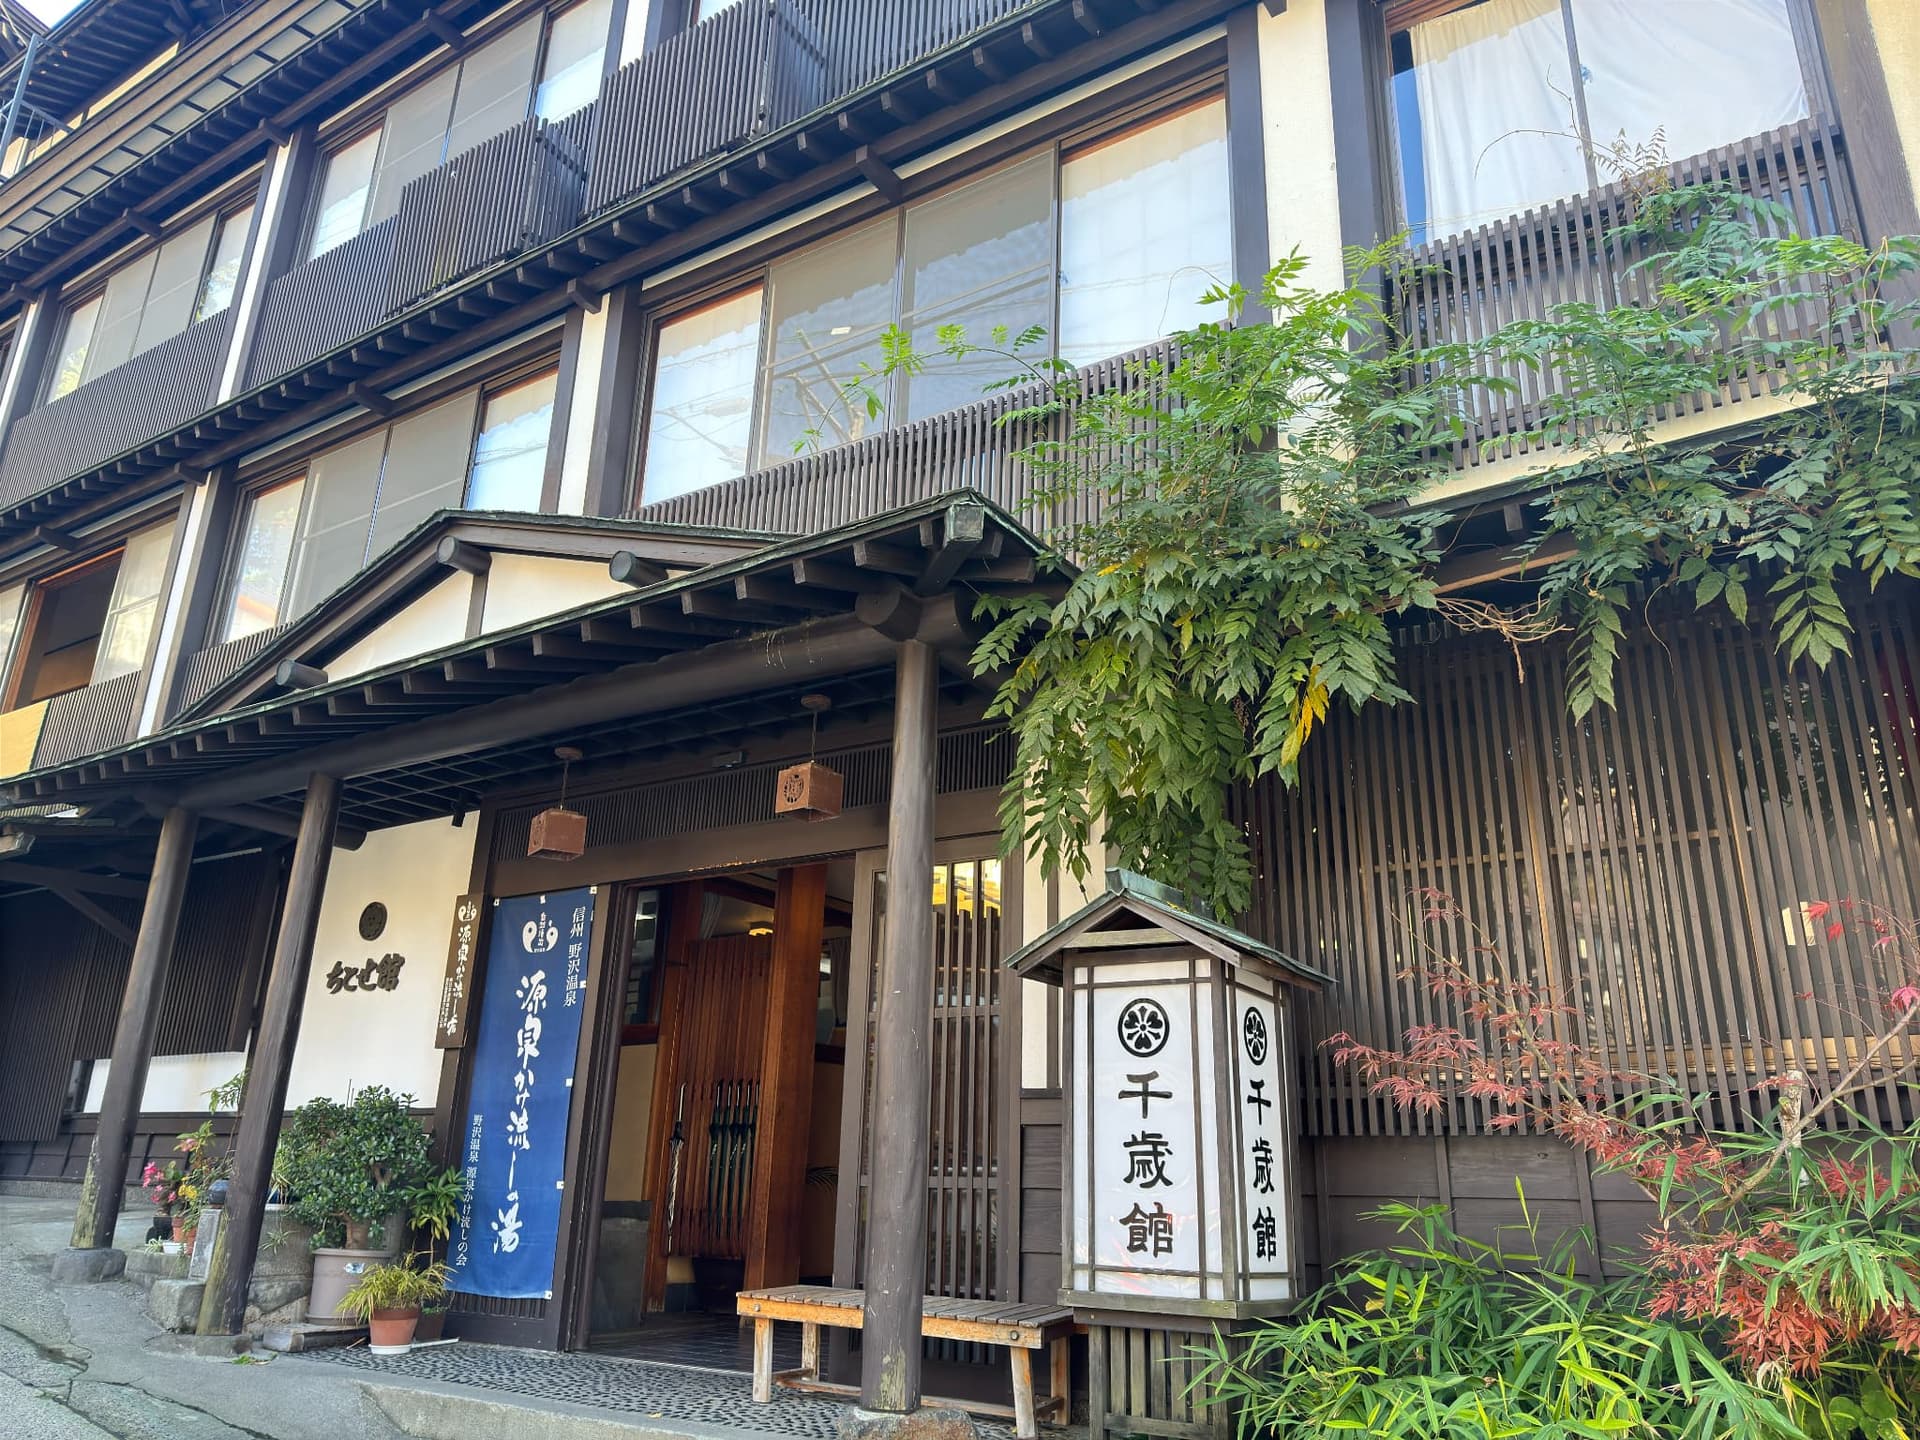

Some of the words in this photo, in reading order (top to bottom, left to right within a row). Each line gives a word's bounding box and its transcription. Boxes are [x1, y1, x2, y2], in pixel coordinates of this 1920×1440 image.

[570, 906, 586, 939] 信州
[326, 953, 405, 994] ちとせ館
[564, 943, 583, 1007] 野沢温泉
[468, 1114, 483, 1163] 野沢温泉
[491, 970, 547, 1255] 源泉かけ流しの湯
[1118, 1070, 1173, 1258] 千歳館
[1247, 1079, 1277, 1262] 千歳館
[455, 1166, 478, 1267] 源泉かけ流しの会
